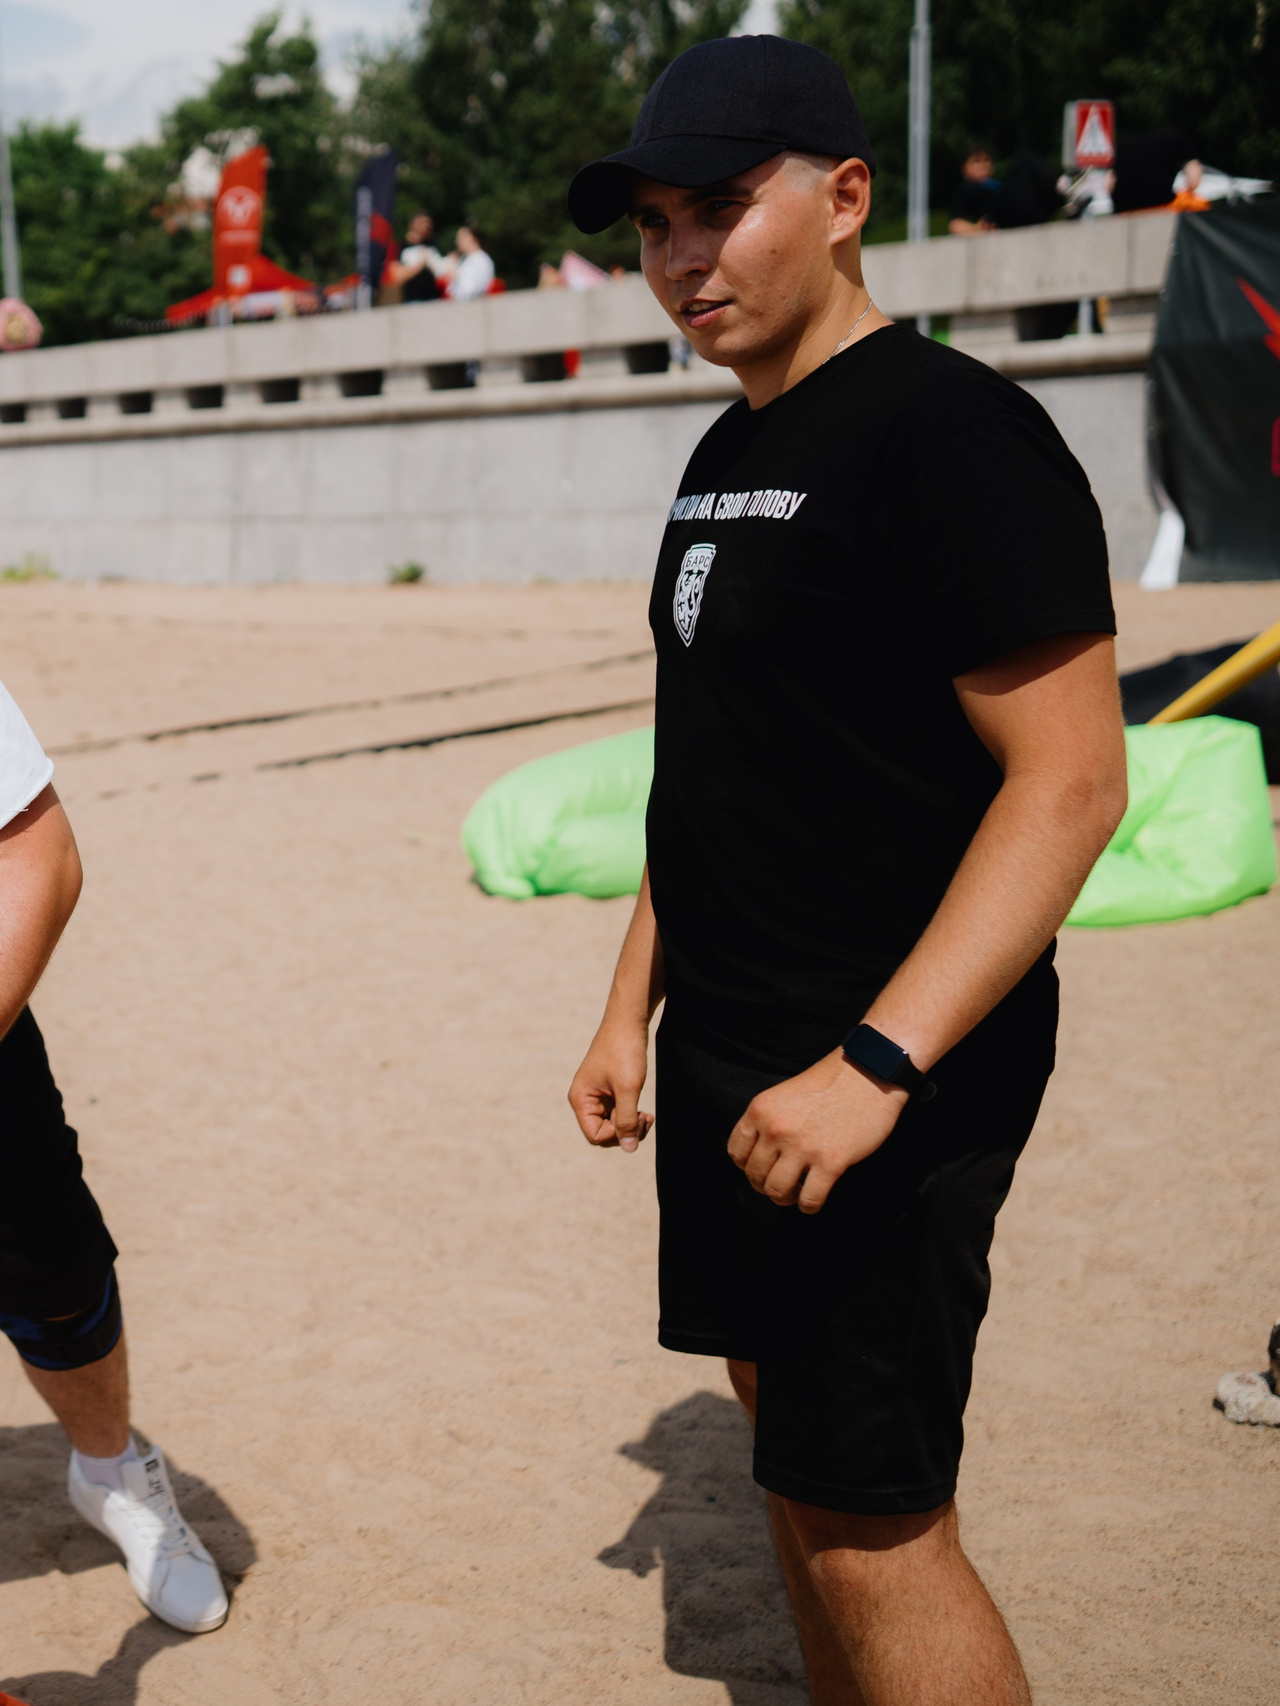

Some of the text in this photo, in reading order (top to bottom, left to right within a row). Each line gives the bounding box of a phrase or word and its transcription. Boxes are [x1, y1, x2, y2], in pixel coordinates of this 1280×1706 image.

[695, 492, 716, 520] НА
[714, 491, 751, 521] СВОЮ
[741, 489, 808, 521] ГОЛОВУ
[685, 554, 711, 569] БАРС
